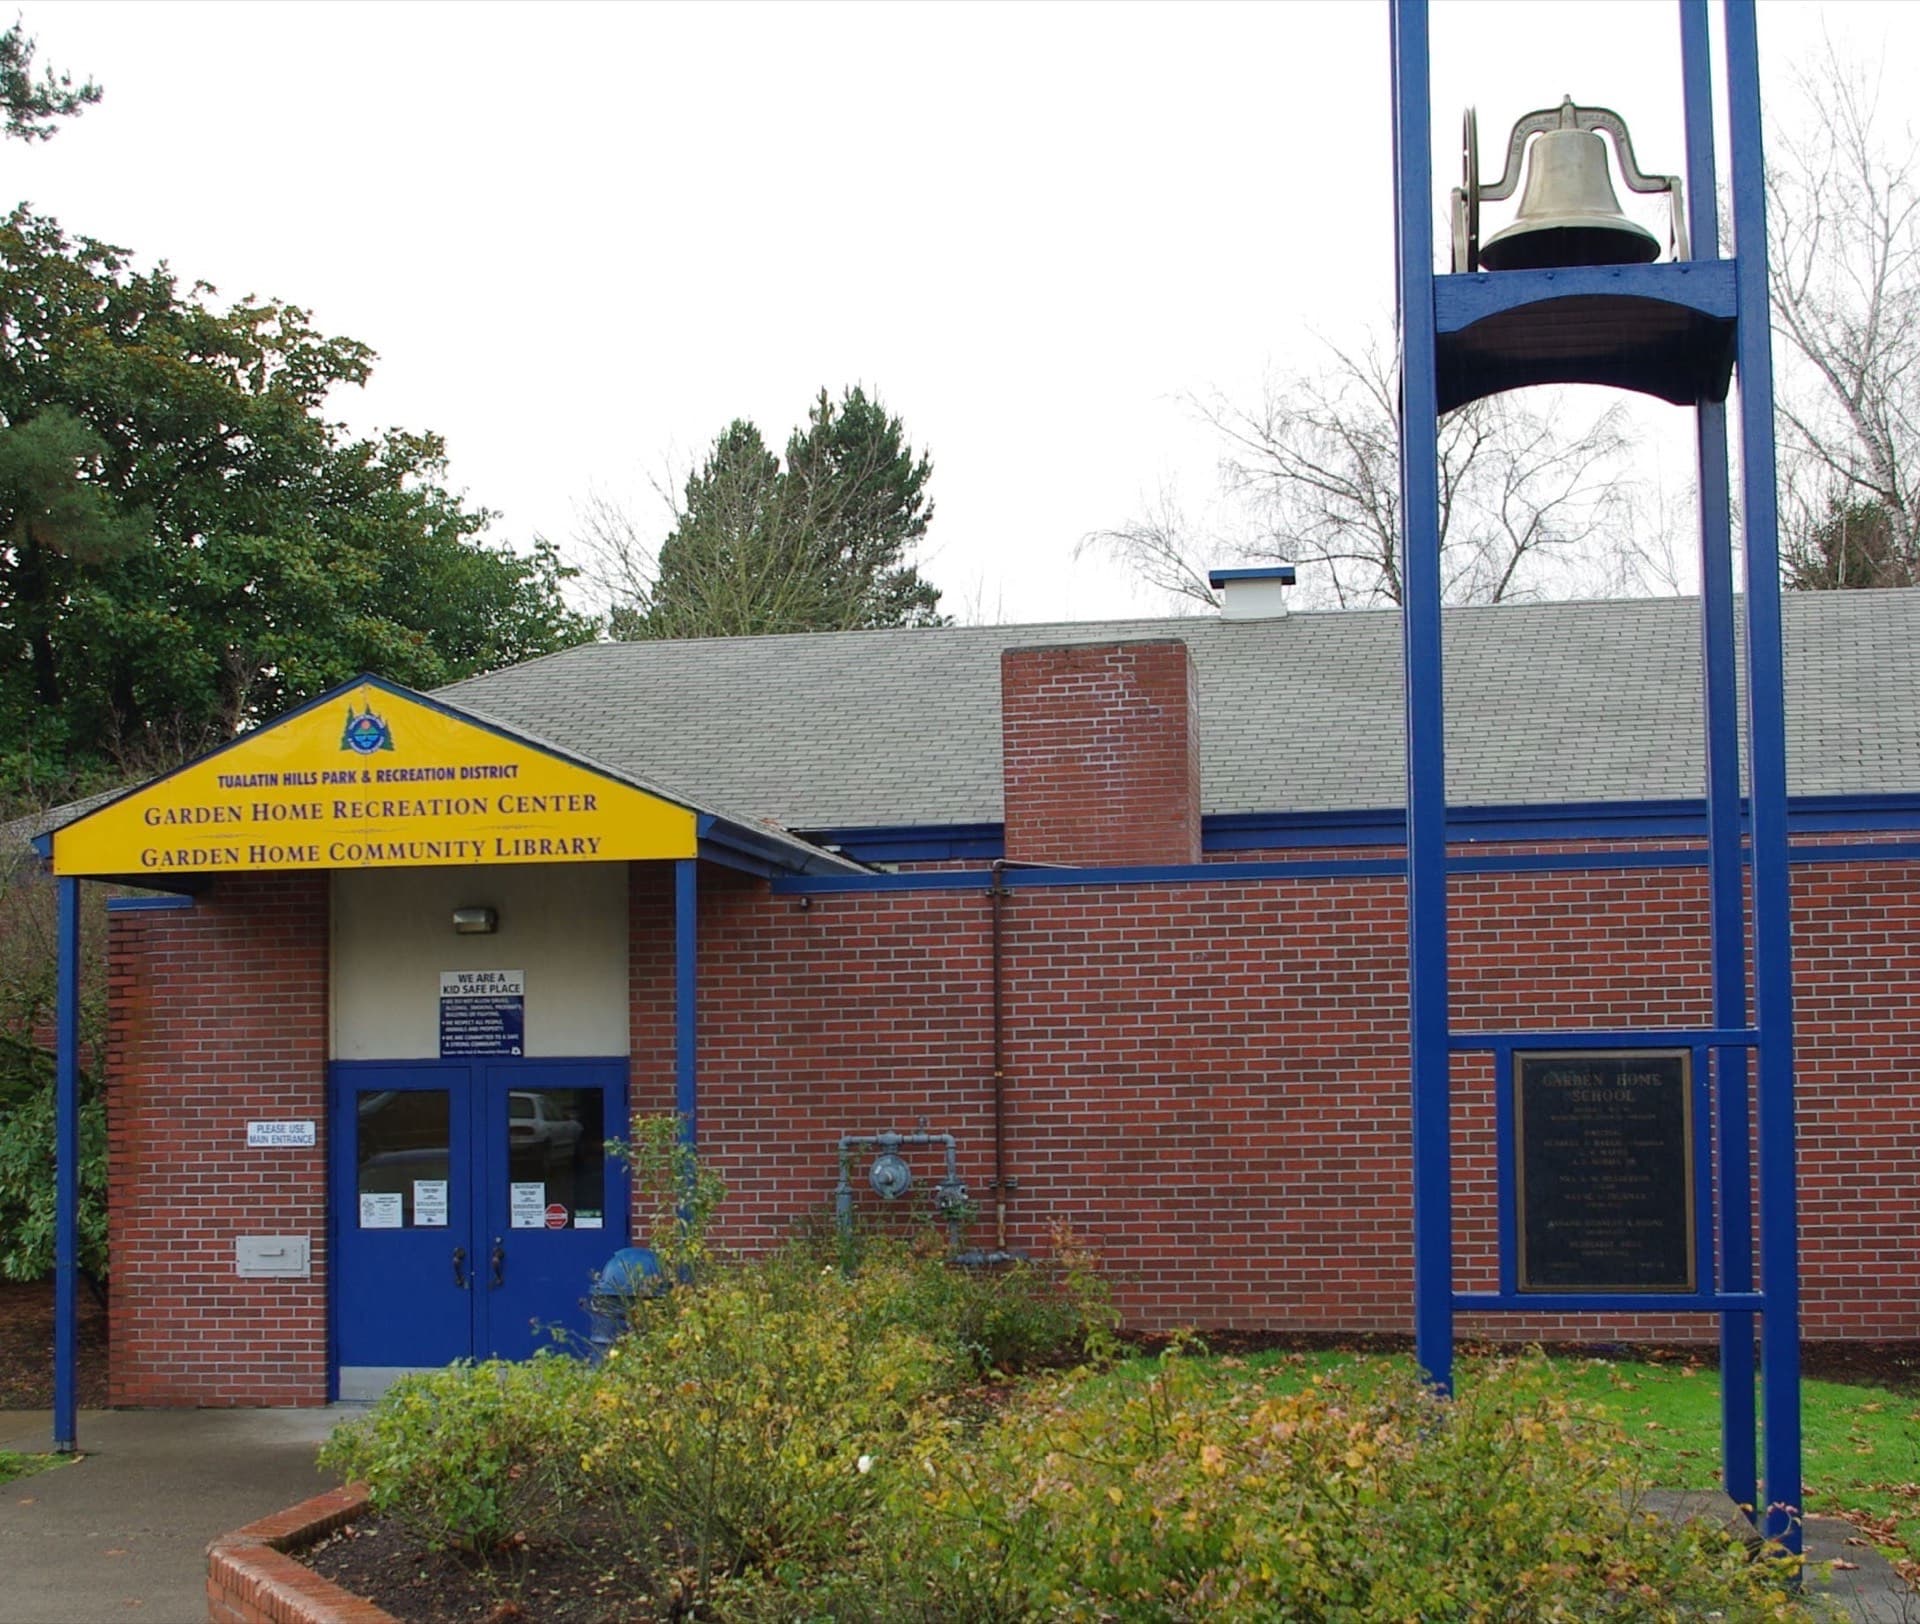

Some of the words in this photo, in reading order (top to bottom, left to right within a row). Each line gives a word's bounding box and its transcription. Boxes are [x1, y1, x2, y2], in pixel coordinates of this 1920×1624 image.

[217, 773, 278, 788] TUALATIN
[283, 771, 317, 785] HILLS
[322, 770, 356, 784] PARK
[361, 770, 371, 783] &
[377, 767, 455, 783] RECREATION
[460, 765, 518, 780] DISTRICT
[144, 806, 242, 826] GARDEN
[252, 803, 323, 821] HOME
[333, 798, 488, 819] RECREATION
[498, 794, 598, 814] CENTER
[141, 848, 239, 867] GARDEN
[248, 845, 320, 863] HOME
[329, 840, 486, 861] COMMUNITY
[495, 837, 602, 857] LIBRARY
[458, 974, 475, 983] WE
[476, 973, 495, 983] ARE
[498, 973, 505, 982] A
[443, 985, 460, 994] KID
[462, 984, 487, 994] SAFE
[489, 984, 520, 993] PLACE
[1543, 1073, 1603, 1087] GARDEN
[1617, 1072, 1663, 1086] HOME
[1572, 1089, 1636, 1102] SCHOOL
[256, 1124, 287, 1134] PLEASE
[289, 1124, 305, 1134] USE
[250, 1135, 269, 1144] MAIN
[271, 1134, 313, 1144] ENTRANCE
